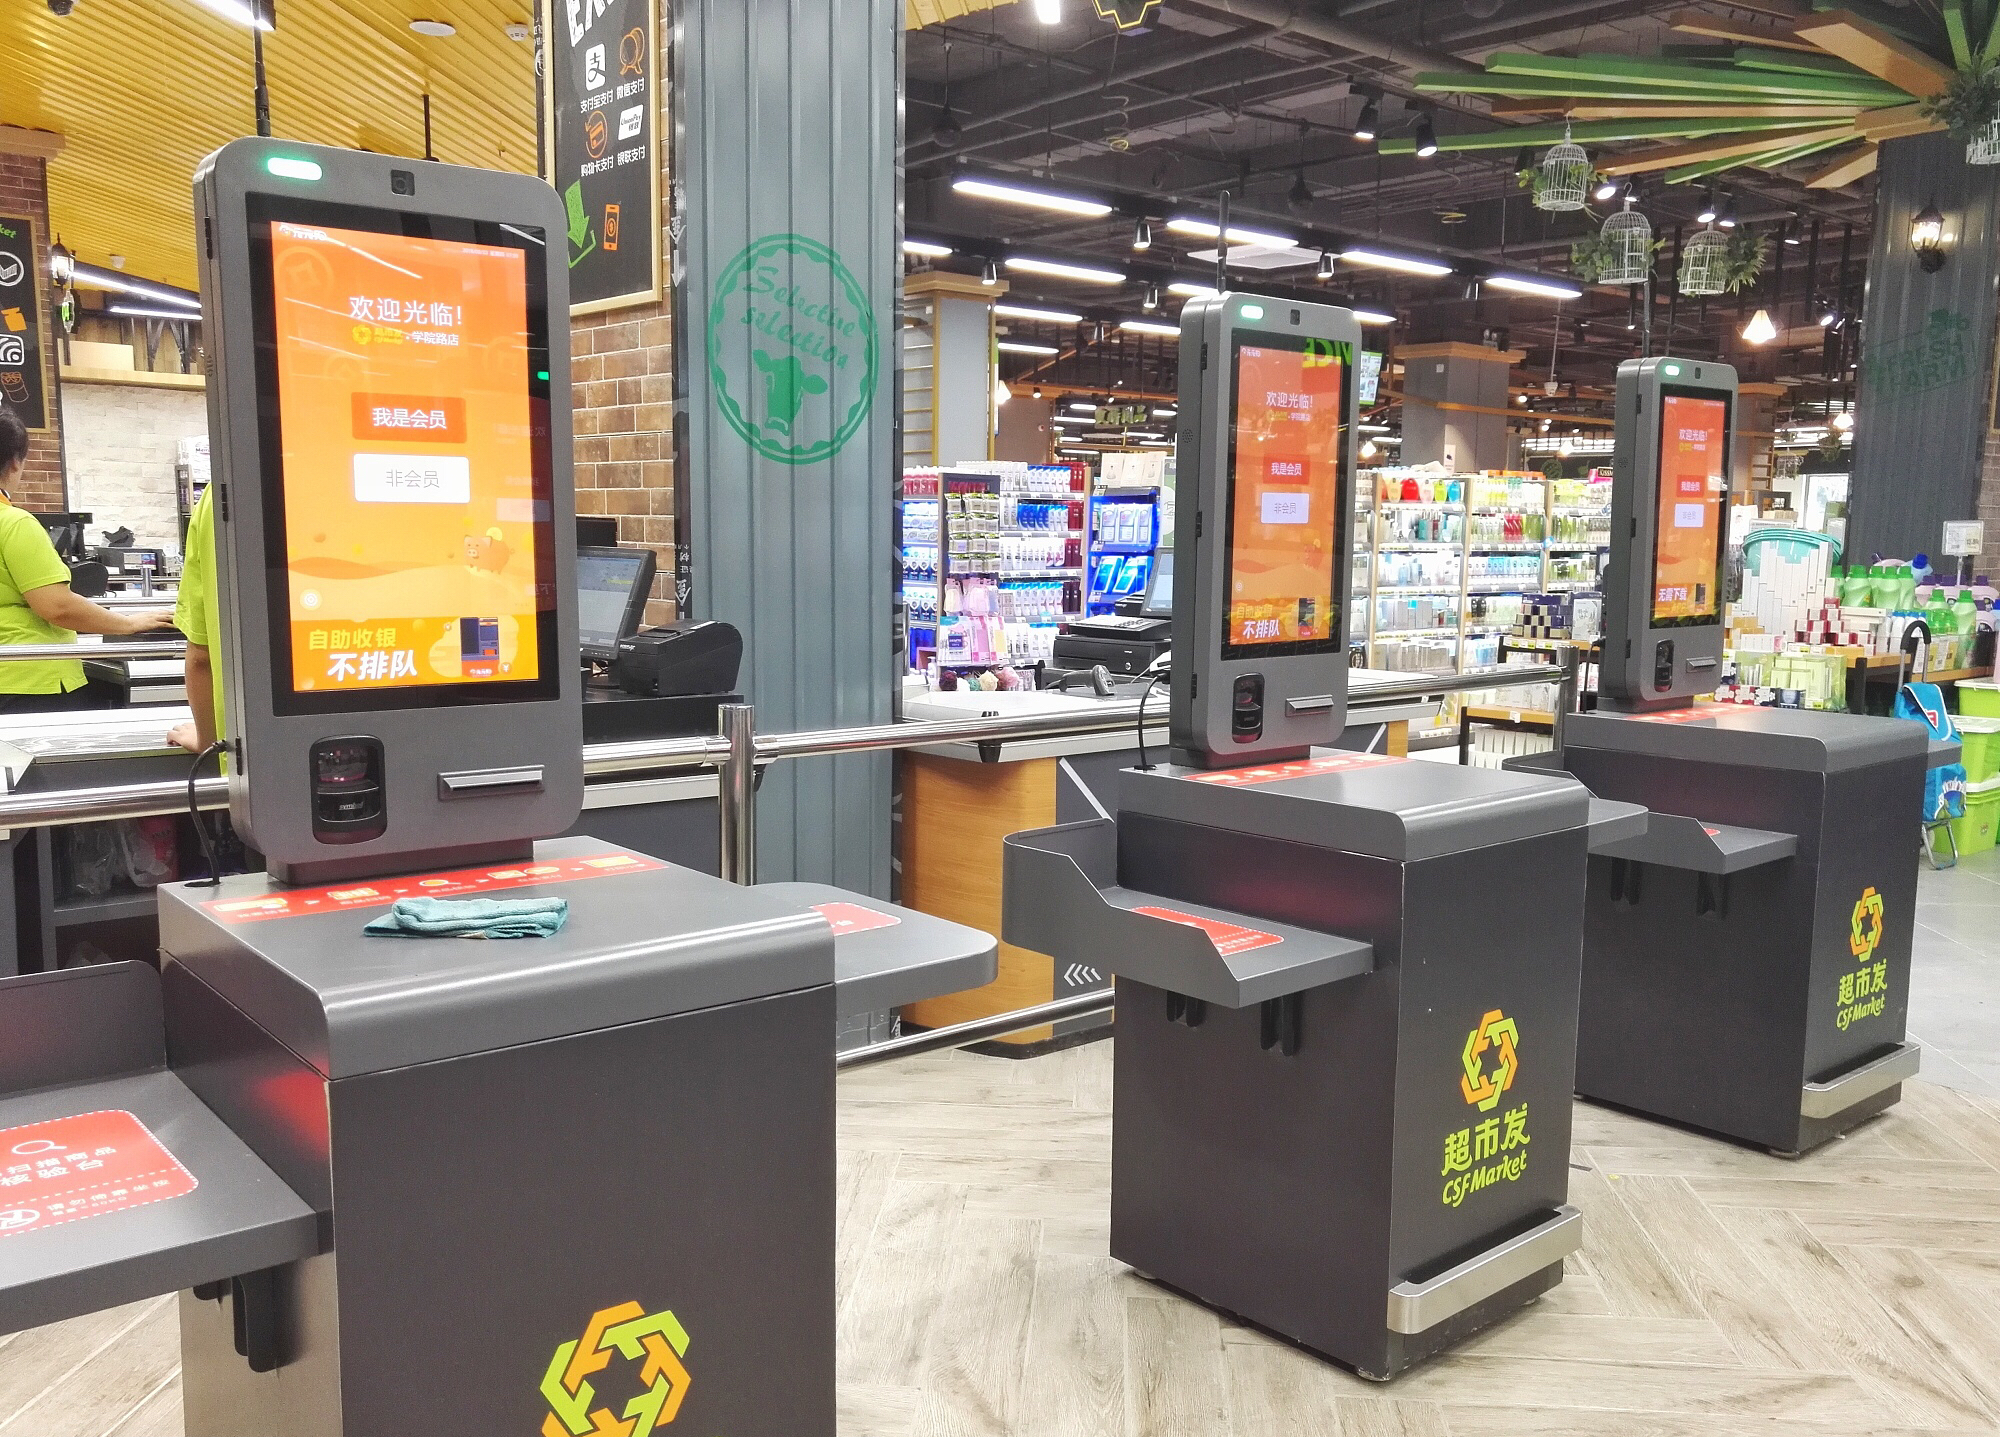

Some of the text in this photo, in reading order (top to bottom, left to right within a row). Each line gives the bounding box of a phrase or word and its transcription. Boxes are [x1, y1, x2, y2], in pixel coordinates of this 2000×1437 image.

[580, 89, 613, 113] 支付宝支付
[372, 407, 447, 429] 我是会员
[386, 469, 440, 489] 非会员
[1271, 462, 1302, 475] 我是会员
[1274, 502, 1297, 514] 非会员
[309, 628, 397, 650] 自助收银
[1243, 619, 1280, 639] 不排队
[327, 650, 418, 681] 不排队
[1837, 958, 1887, 1007] 超市发
[1442, 1103, 1530, 1176] 超市发
[0, 1146, 117, 1176] 扫描商品
